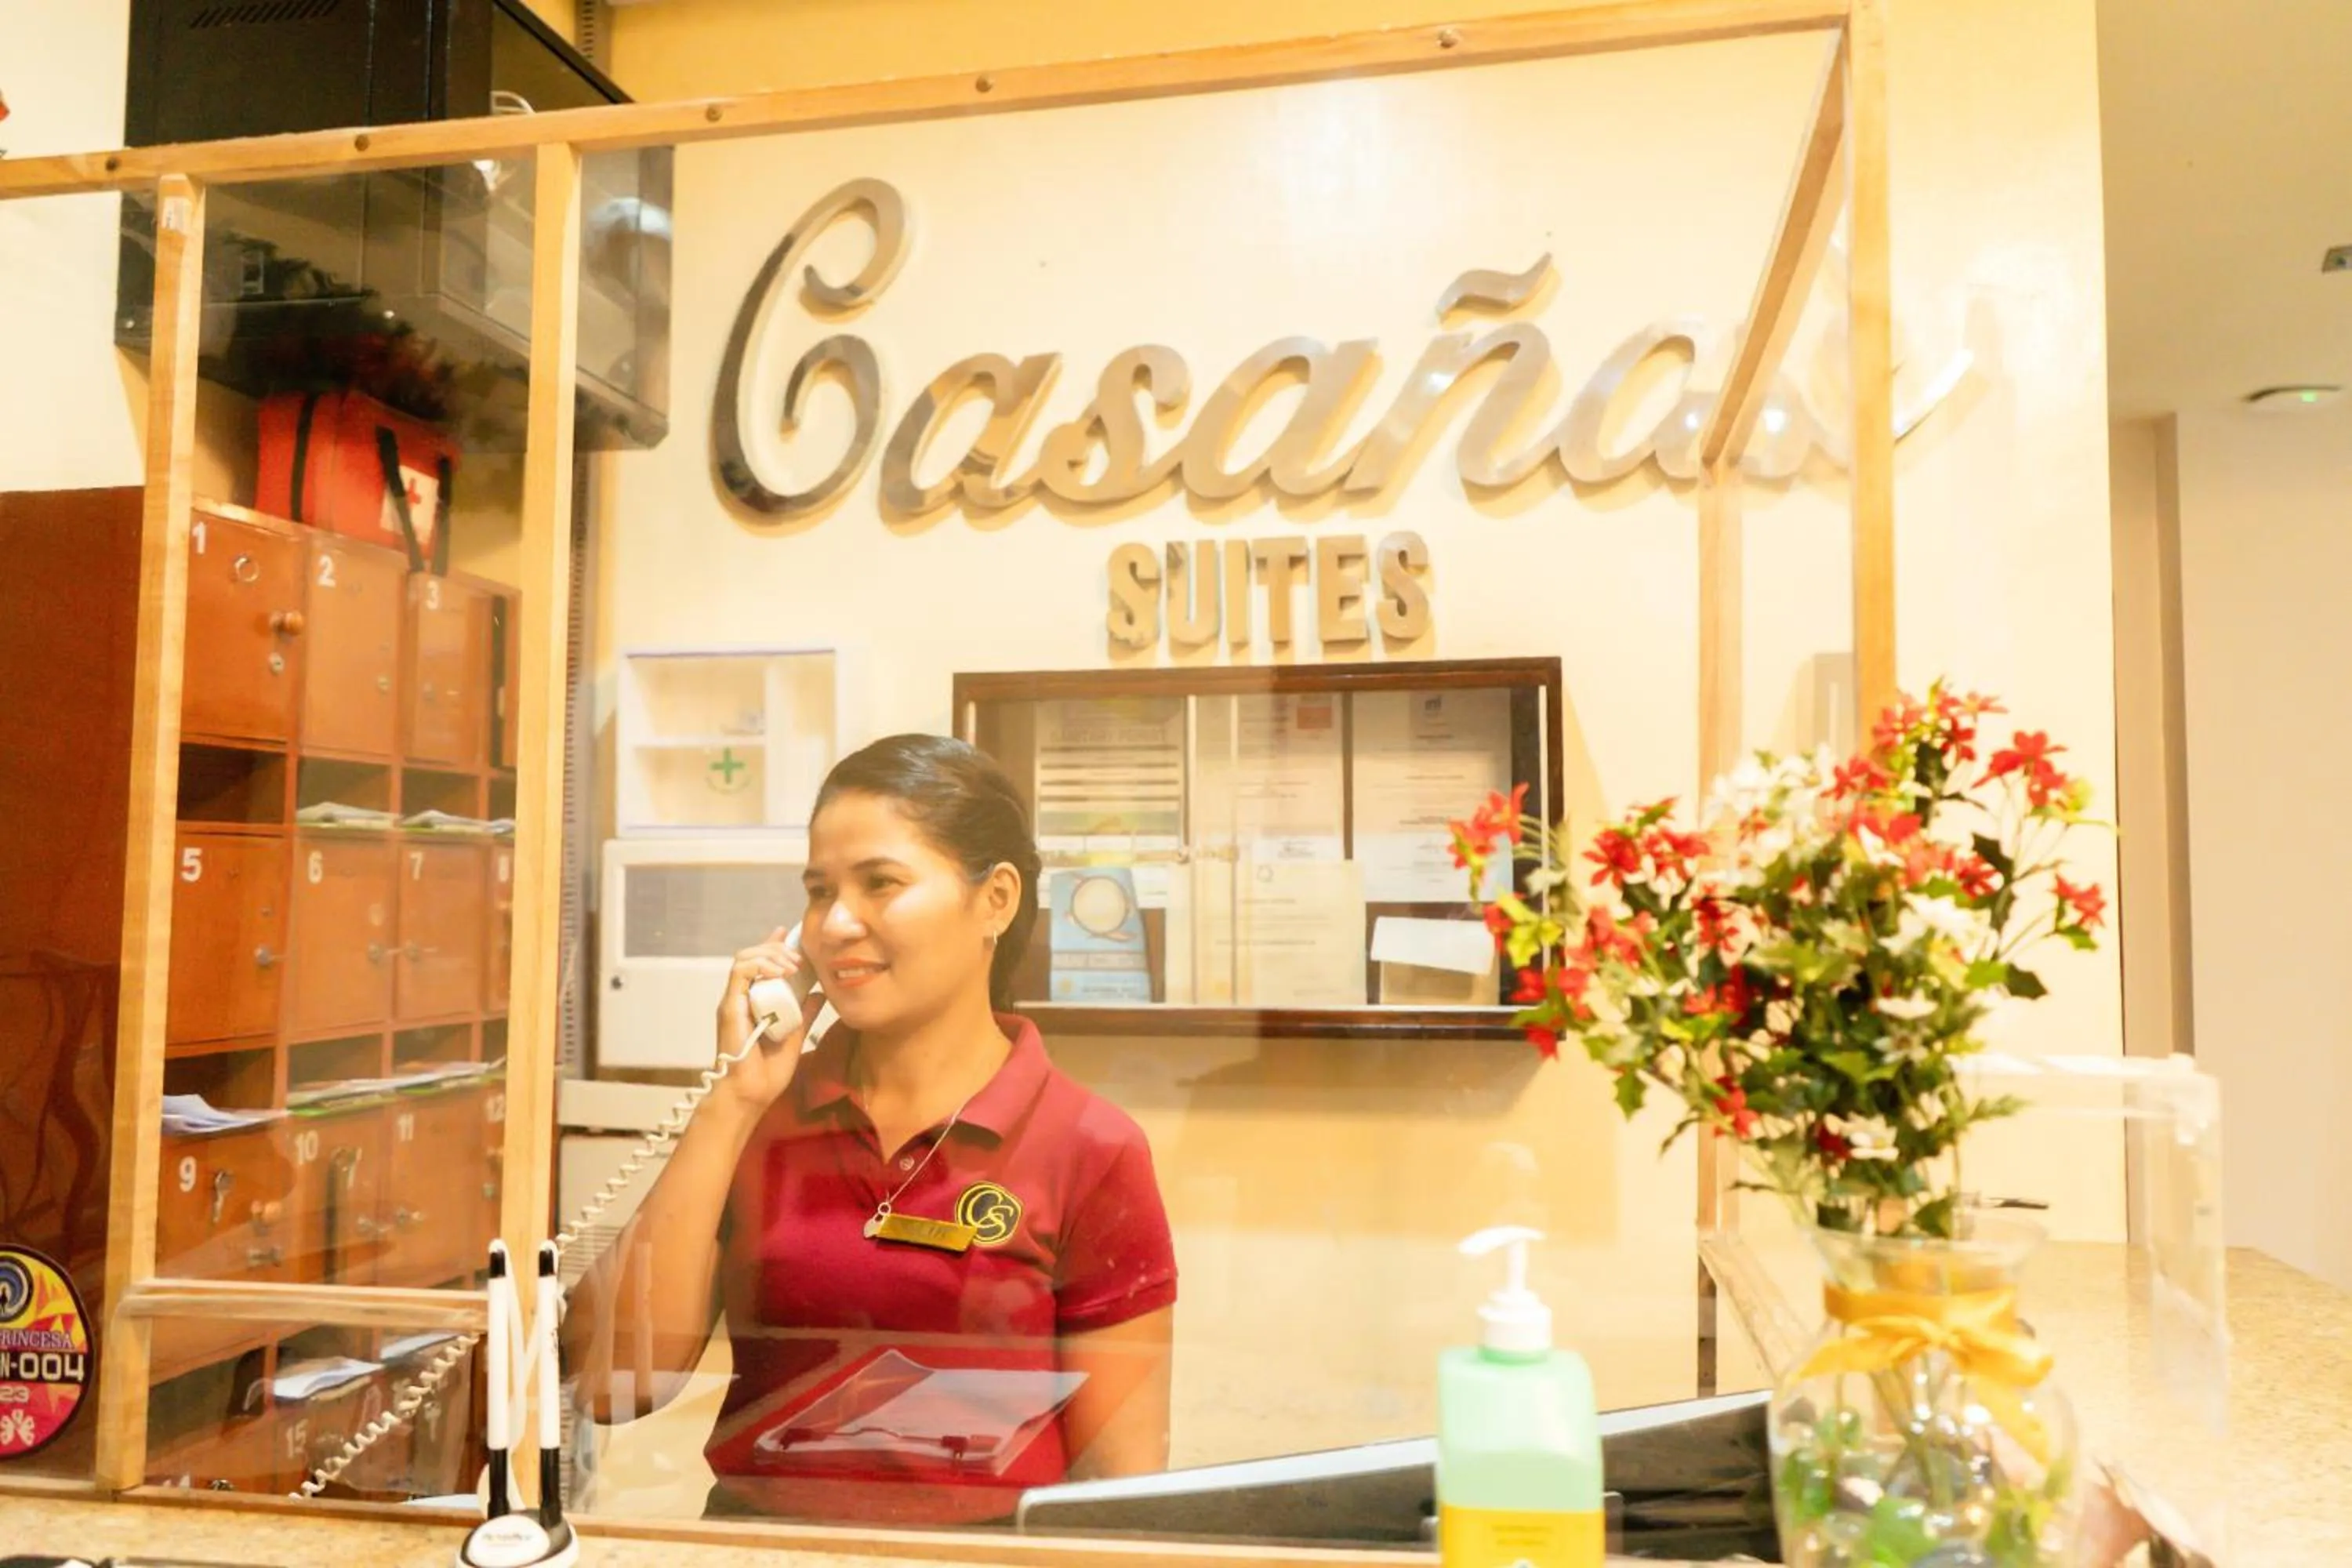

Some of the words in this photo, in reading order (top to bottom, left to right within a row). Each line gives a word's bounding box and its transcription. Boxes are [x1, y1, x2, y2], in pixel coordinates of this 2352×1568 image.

[192, 521, 206, 554] 1
[318, 556, 336, 587] 2
[426, 581, 440, 610] 3
[1106, 531, 1430, 648] SUITES
[181, 848, 202, 882] 5
[308, 851, 323, 884] 6
[410, 851, 423, 880] 7
[397, 1113, 414, 1142] 11
[296, 1130, 318, 1165] 10
[180, 1156, 196, 1192] 9
[0, 1328, 74, 1348] RINCESA
